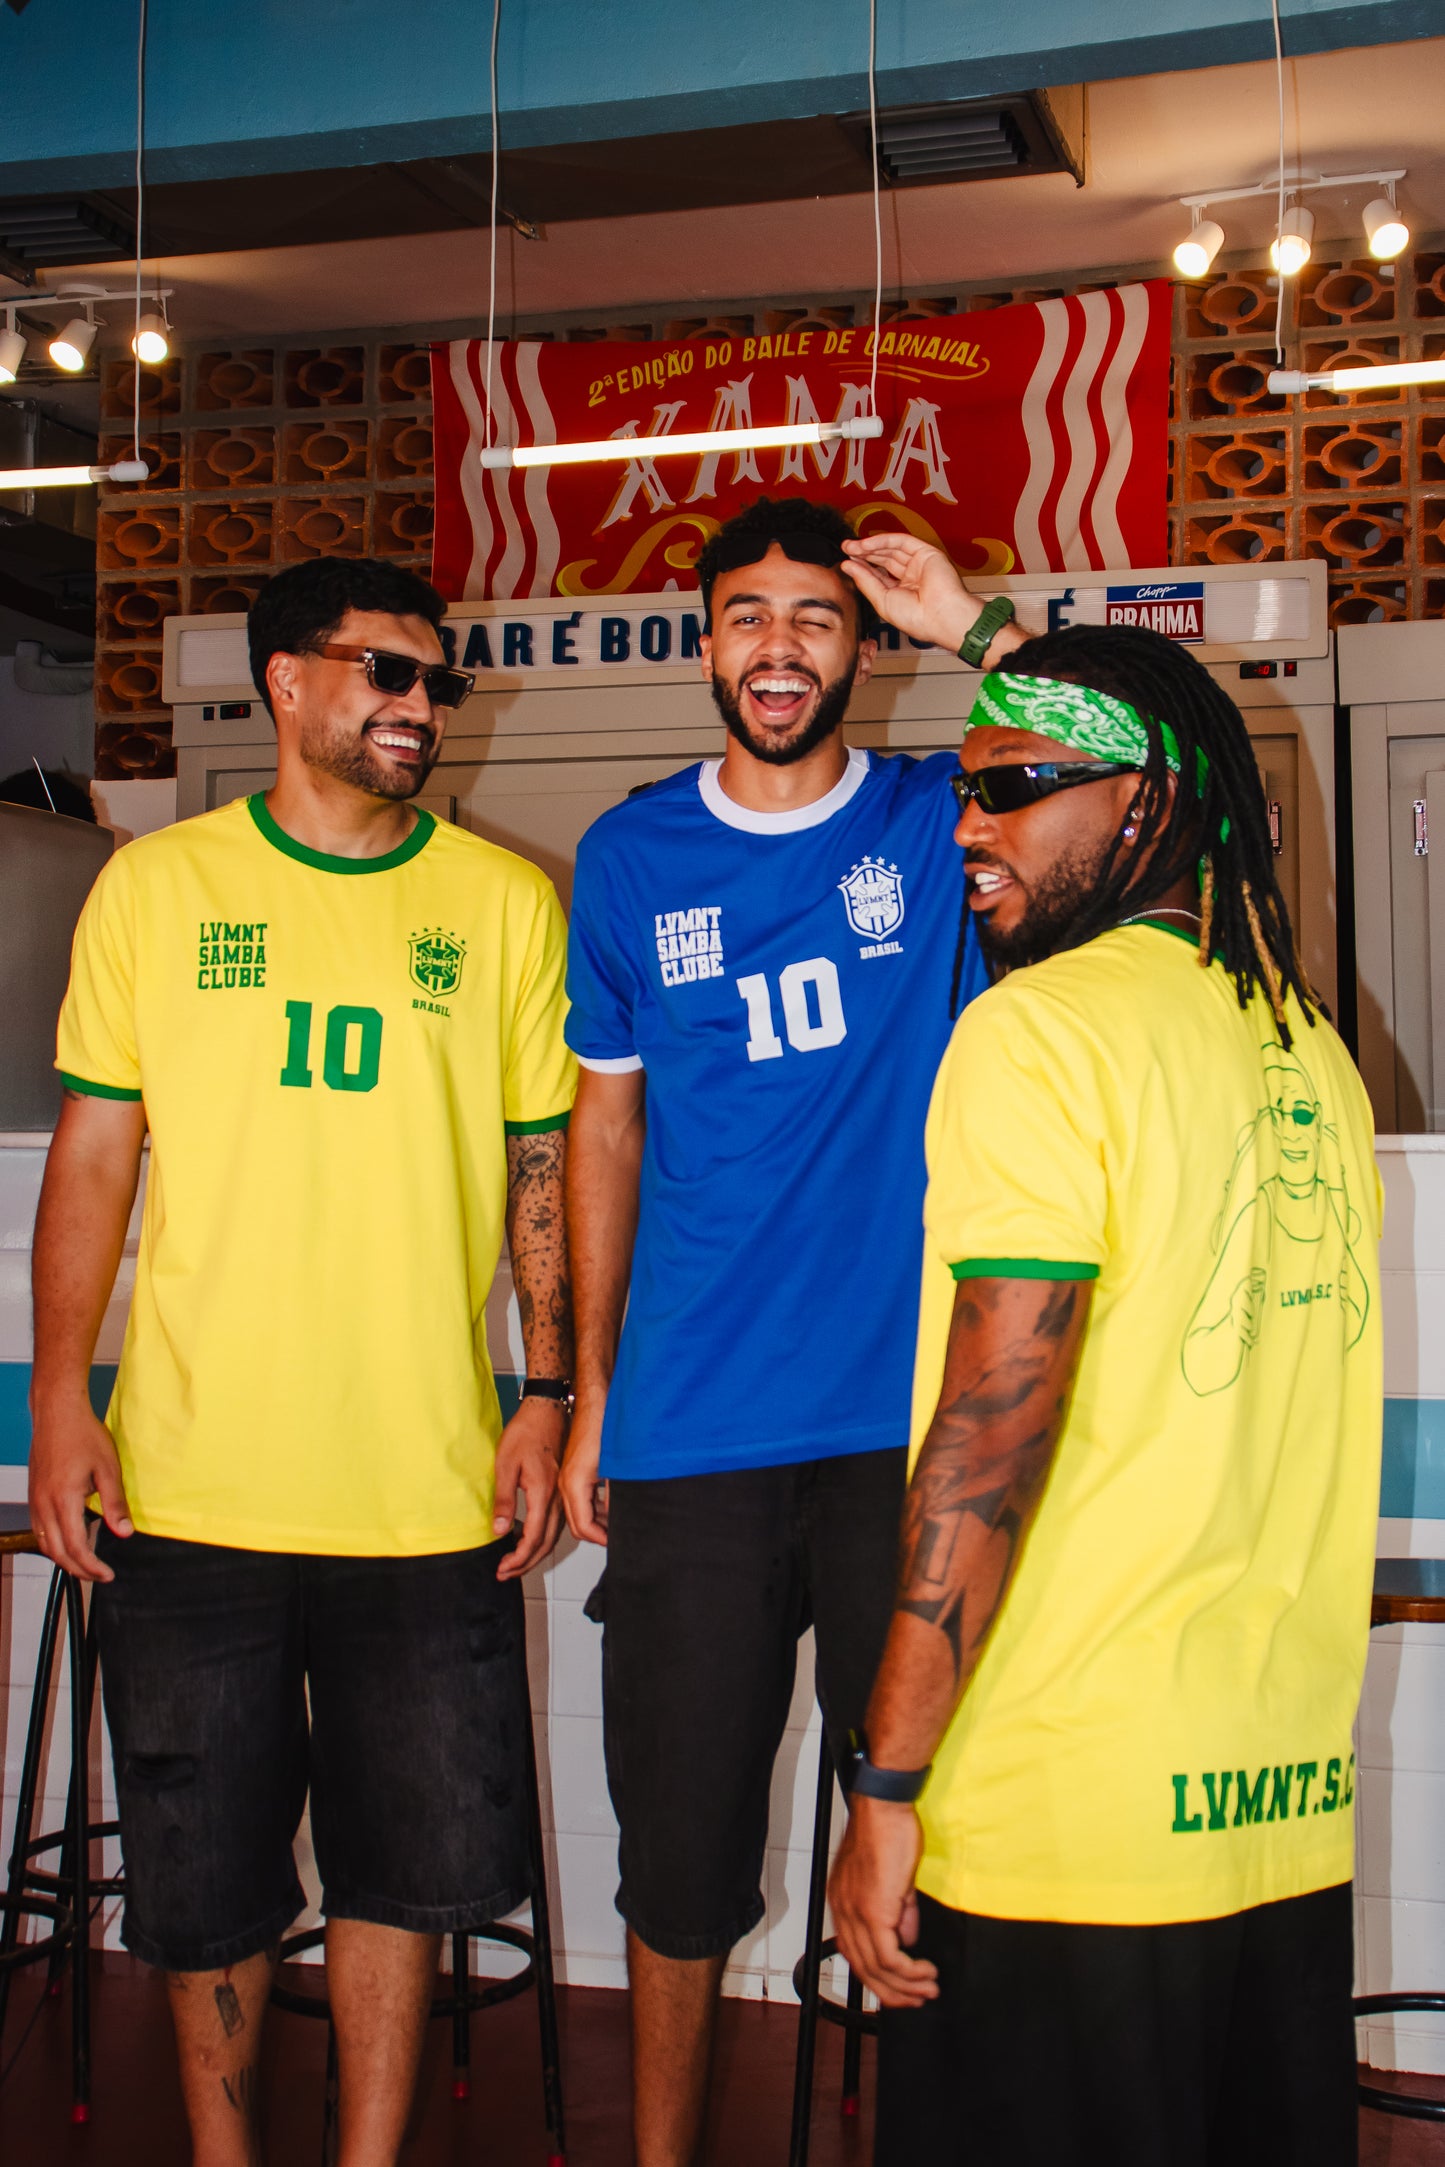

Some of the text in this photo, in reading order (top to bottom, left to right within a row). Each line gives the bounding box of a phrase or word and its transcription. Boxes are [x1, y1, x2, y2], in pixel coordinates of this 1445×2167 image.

[705, 341, 732, 369] DO
[742, 331, 814, 362] BAILE
[823, 330, 856, 354] DE
[863, 331, 981, 368] CARNAVAL
[592, 372, 958, 536] XAMA
[1136, 585, 1178, 599] Chopp
[1110, 604, 1199, 634] BRAHMA
[552, 611, 584, 665] É
[858, 894, 890, 906] LVMNT
[199, 922, 268, 943] LVMNT
[655, 906, 722, 938] LVMNT
[199, 944, 267, 967] SAMBA
[656, 929, 723, 963] SAMBA
[859, 941, 904, 960] BRASIL
[197, 967, 266, 990] CLUBE
[660, 952, 725, 988] CLUBE
[412, 998, 451, 1018] BRASIL
[736, 956, 848, 1062] 10
[280, 999, 384, 1093] 10
